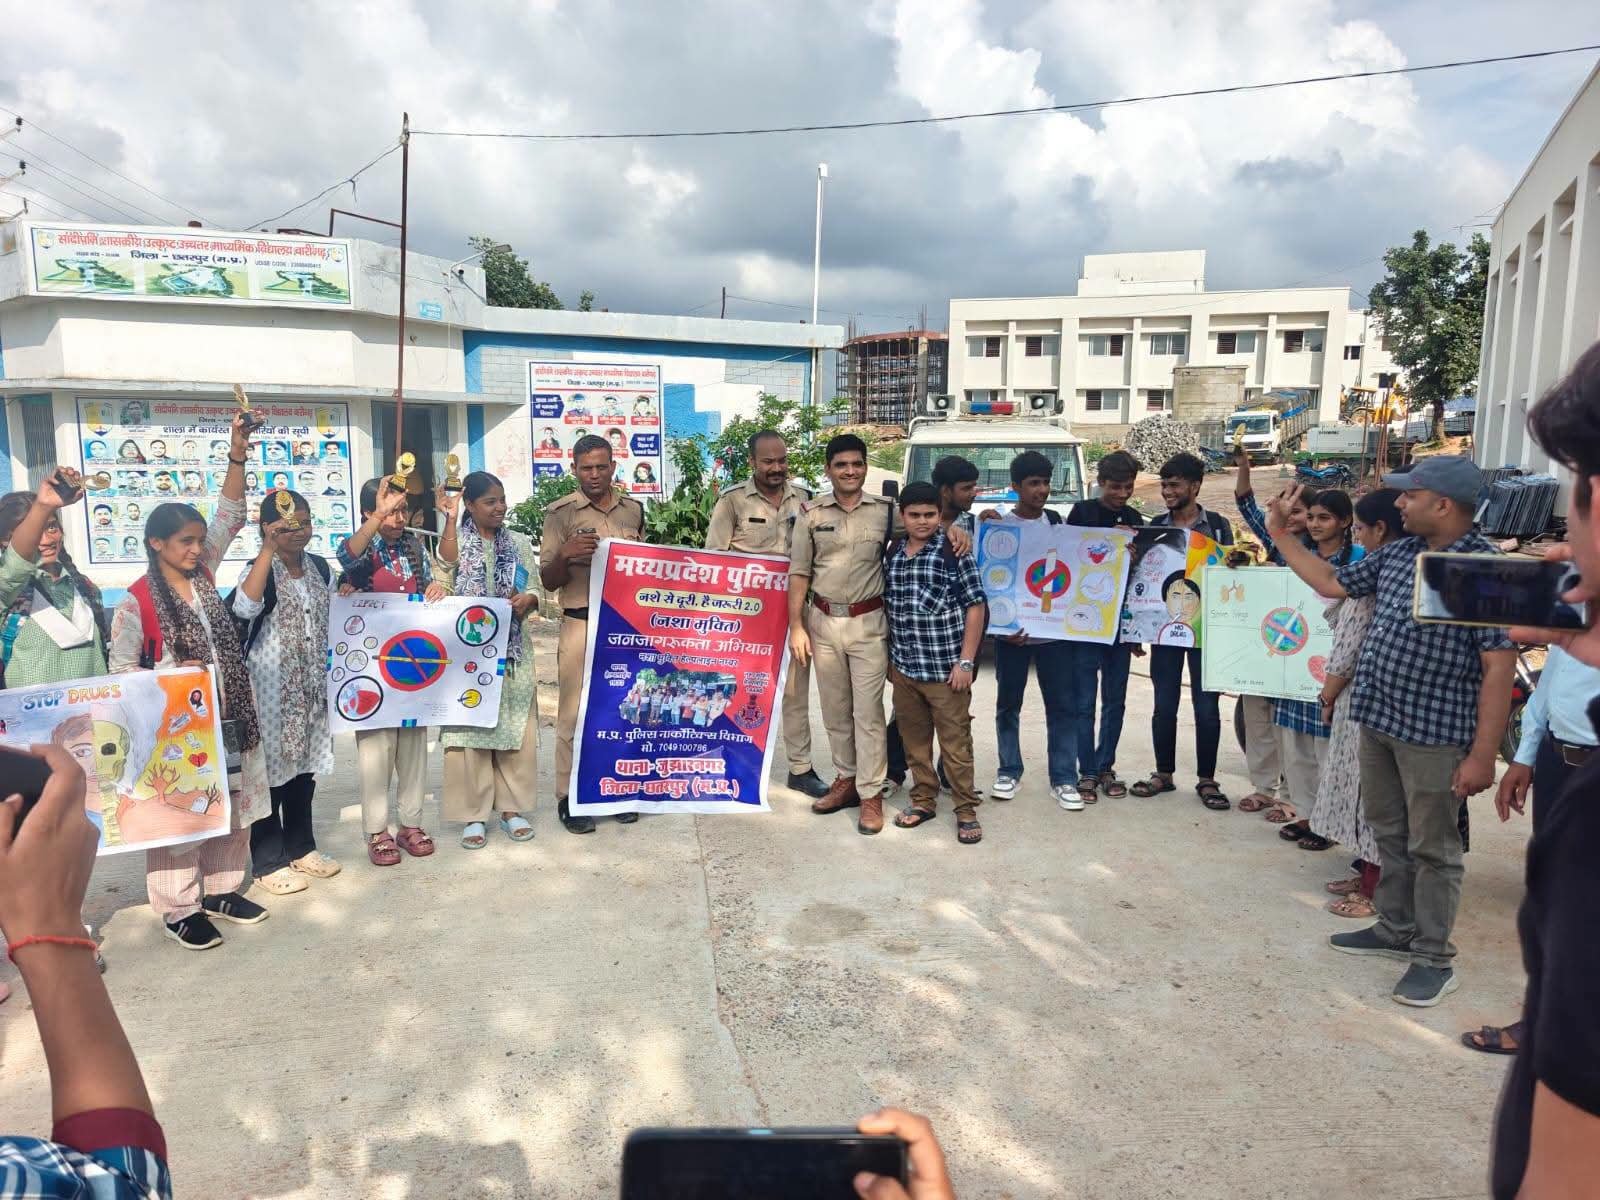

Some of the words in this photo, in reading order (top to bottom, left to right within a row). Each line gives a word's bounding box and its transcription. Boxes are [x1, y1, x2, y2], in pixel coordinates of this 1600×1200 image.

[130, 250, 159, 259] जिला
[613, 555, 723, 585] मध्यप्रदेश
[727, 563, 790, 594] पुलिस
[639, 590, 660, 602] नशे
[663, 591, 674, 604] से
[701, 594, 711, 608] है
[712, 596, 743, 611] जरूरी
[744, 602, 760, 612] 2.0
[650, 612, 690, 629] (नशा
[694, 615, 741, 635] मुक्ति)
[608, 633, 712, 651] जनजागरूकता
[716, 639, 774, 656] अभियान
[22, 690, 65, 711] STOP
[67, 684, 122, 705] DRUGS
[625, 728, 657, 744] पुलिस
[719, 729, 753, 744] विभाग
[641, 742, 656, 753] मो.
[658, 743, 707, 752] 7049100786
